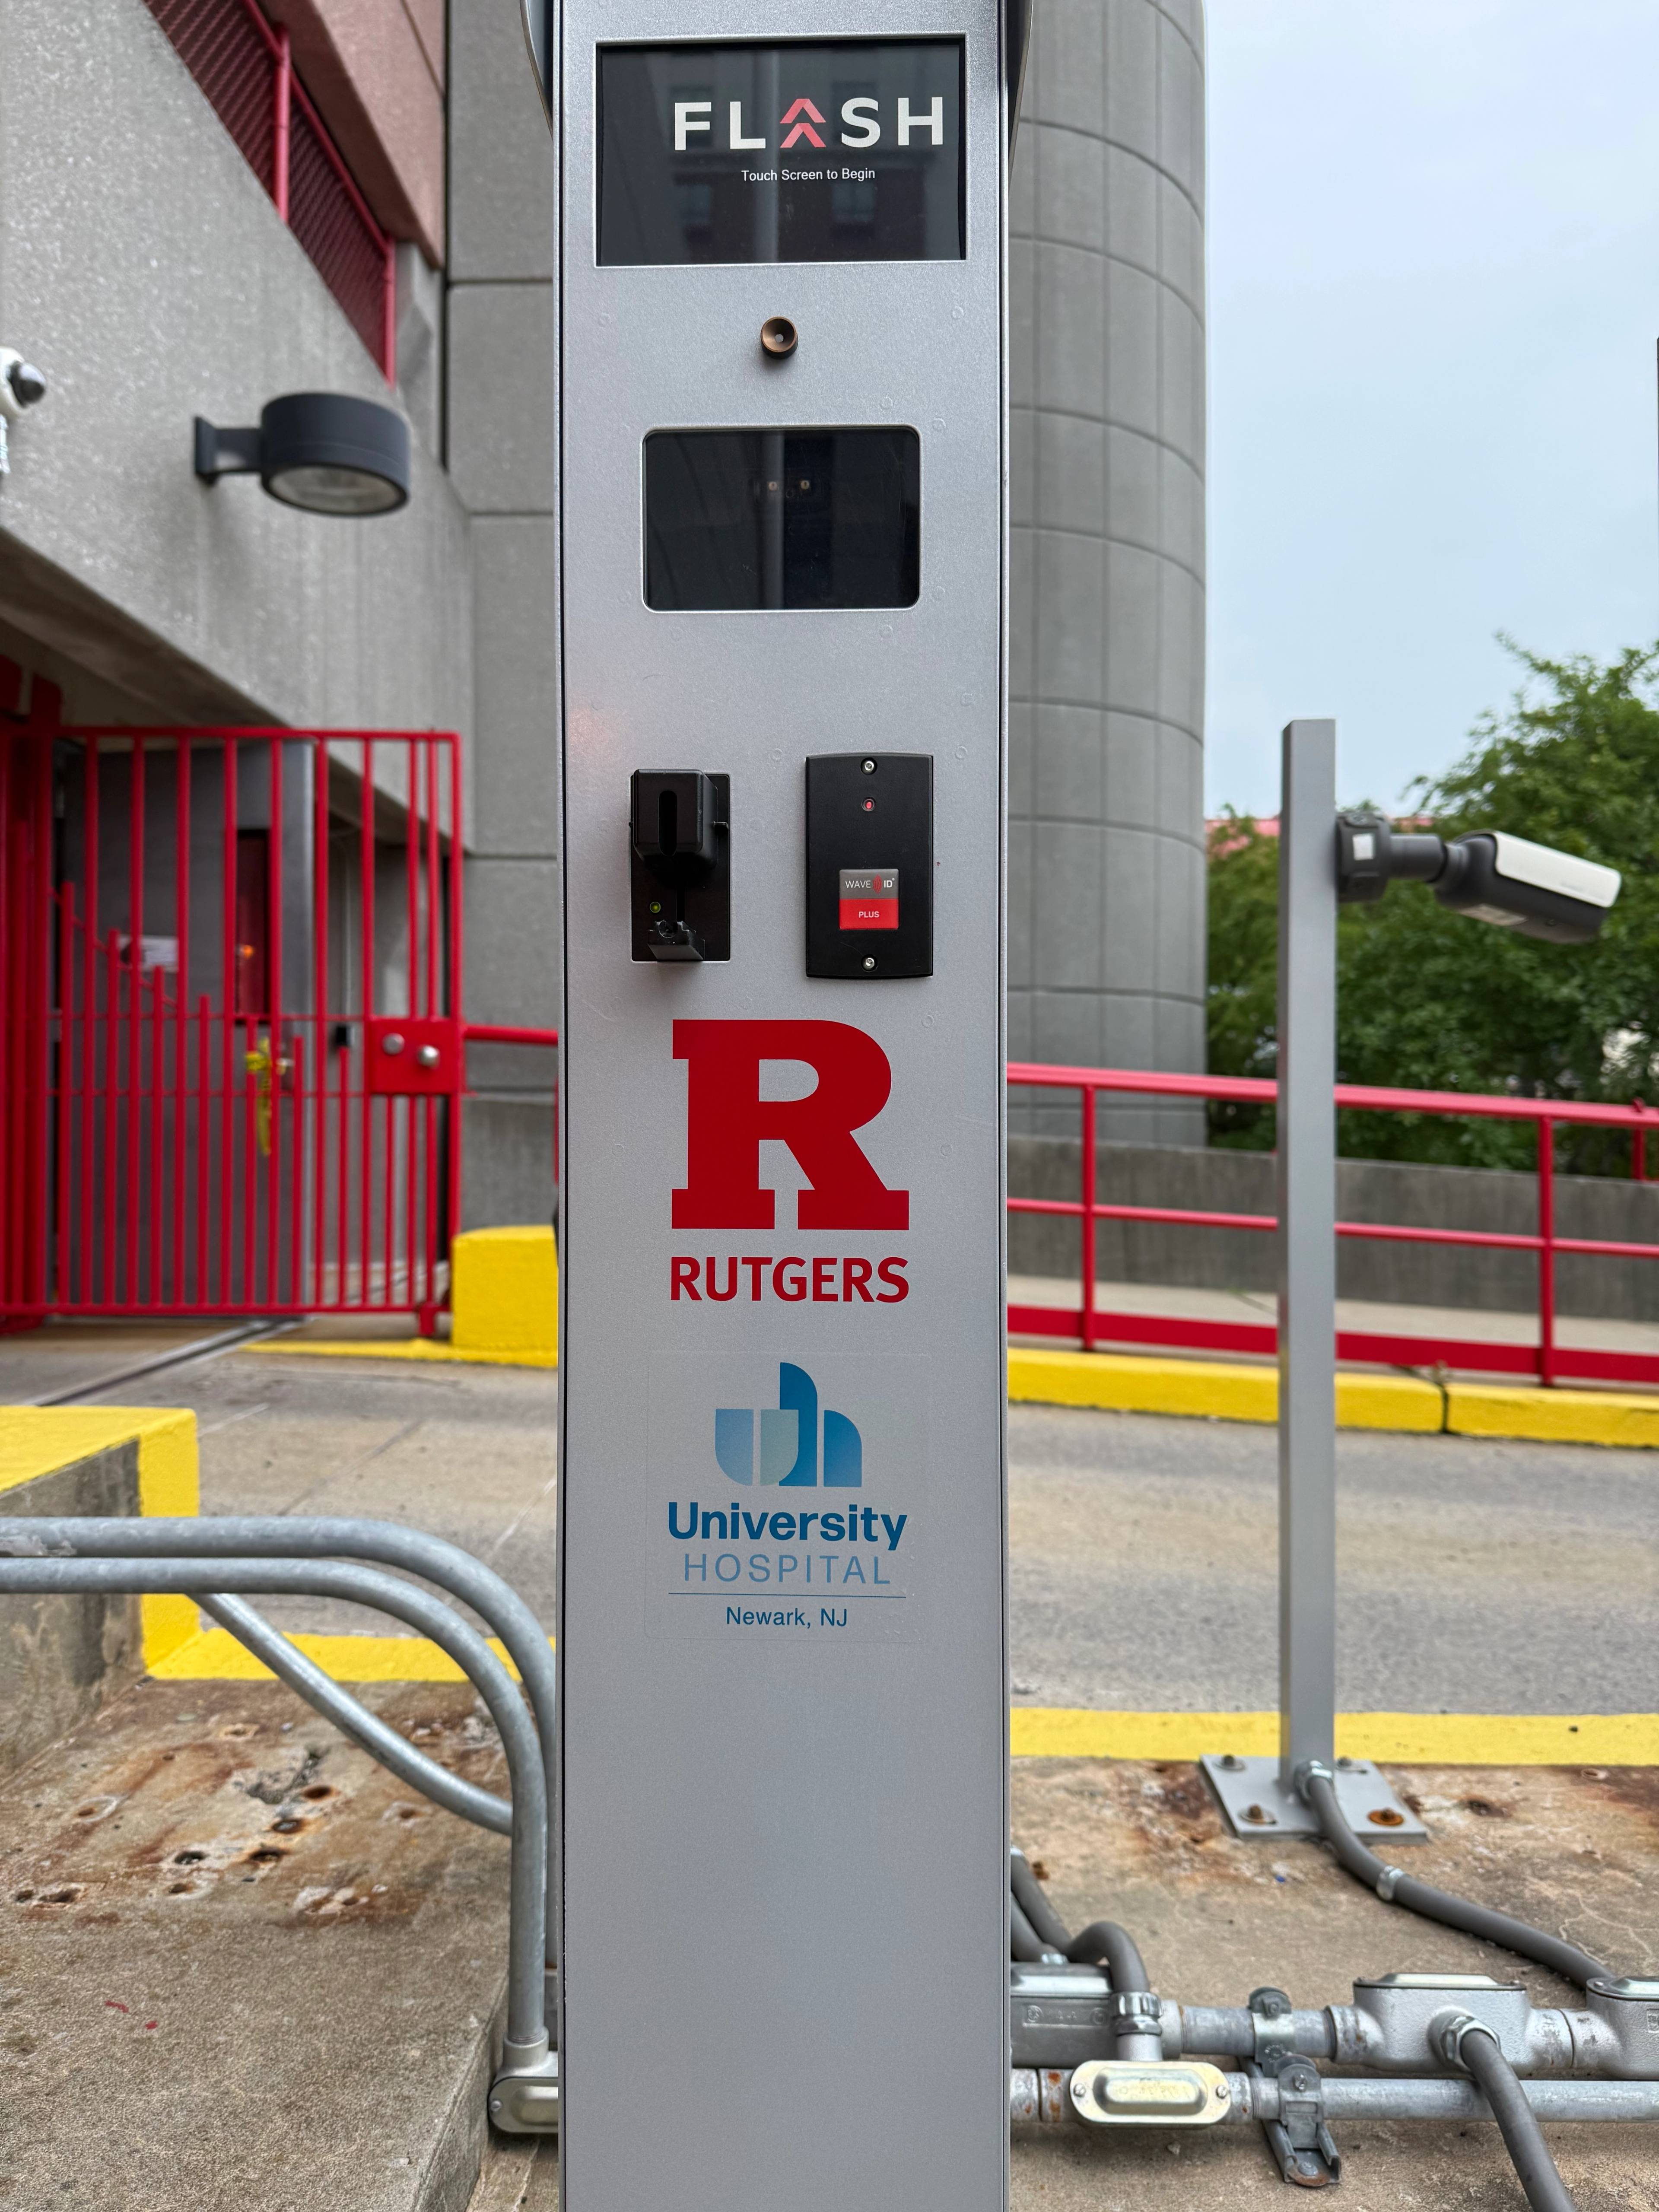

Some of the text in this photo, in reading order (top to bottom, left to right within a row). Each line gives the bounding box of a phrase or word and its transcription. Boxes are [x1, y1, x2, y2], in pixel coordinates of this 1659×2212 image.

[675, 97, 943, 150] FLASH
[741, 168, 875, 181] Touch Screen to Begin
[845, 880, 871, 888] WAVE
[672, 1020, 909, 1230] R
[671, 1256, 909, 1303] RUTGERS
[668, 1502, 907, 1551] University
[685, 1554, 890, 1584] HOSPITAL
[727, 1607, 848, 1628] Newark, NJ
